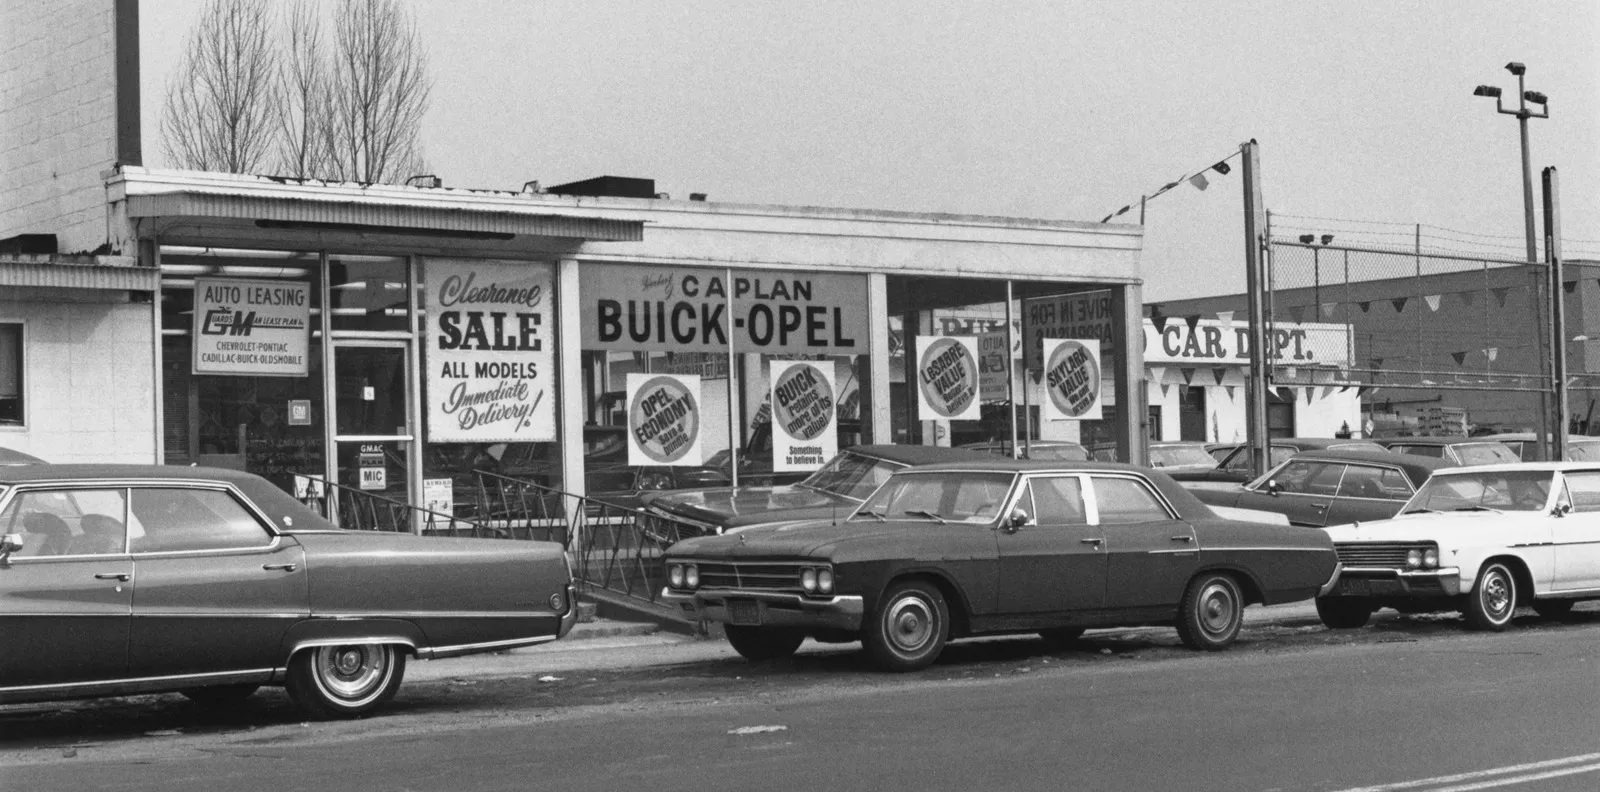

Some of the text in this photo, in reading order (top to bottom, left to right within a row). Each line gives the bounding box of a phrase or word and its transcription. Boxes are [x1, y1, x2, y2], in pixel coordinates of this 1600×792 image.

[204, 286, 304, 307] AUTO LEASING
[439, 271, 541, 307] Clearance
[682, 275, 812, 301] CAPLAN
[263, 317, 281, 325] LEASE
[281, 317, 298, 325] PLAN
[439, 311, 541, 351] SALE
[598, 299, 854, 347] BUICK-OPEL
[216, 341, 288, 352] CHEVROLET-PONTIAC
[1163, 326, 1226, 357] CAR
[202, 353, 302, 365] CADILLAC-BUICK-OLDSMOBILE
[441, 361, 537, 379] ALL MODELS
[920, 341, 964, 385] LeSABRE
[1047, 345, 1088, 388] SKYLARK
[775, 366, 817, 407] BUICK
[934, 362, 966, 395] VALUE
[1059, 365, 1089, 399] VALUE
[442, 380, 529, 414] Immediate
[458, 389, 544, 432] Delivery!
[641, 387, 672, 417] OPEL
[788, 388, 819, 416] retains
[293, 405, 306, 418] GM
[635, 393, 692, 445] ECONOMY
[787, 396, 832, 434] more of its
[677, 423, 684, 433] a
[802, 413, 829, 439] value!
[360, 445, 384, 453] GMAC
[663, 432, 689, 456] bundle
[789, 445, 823, 456] Something
[786, 456, 793, 465] to
[794, 456, 816, 465] believe
[364, 471, 382, 482] MIC
